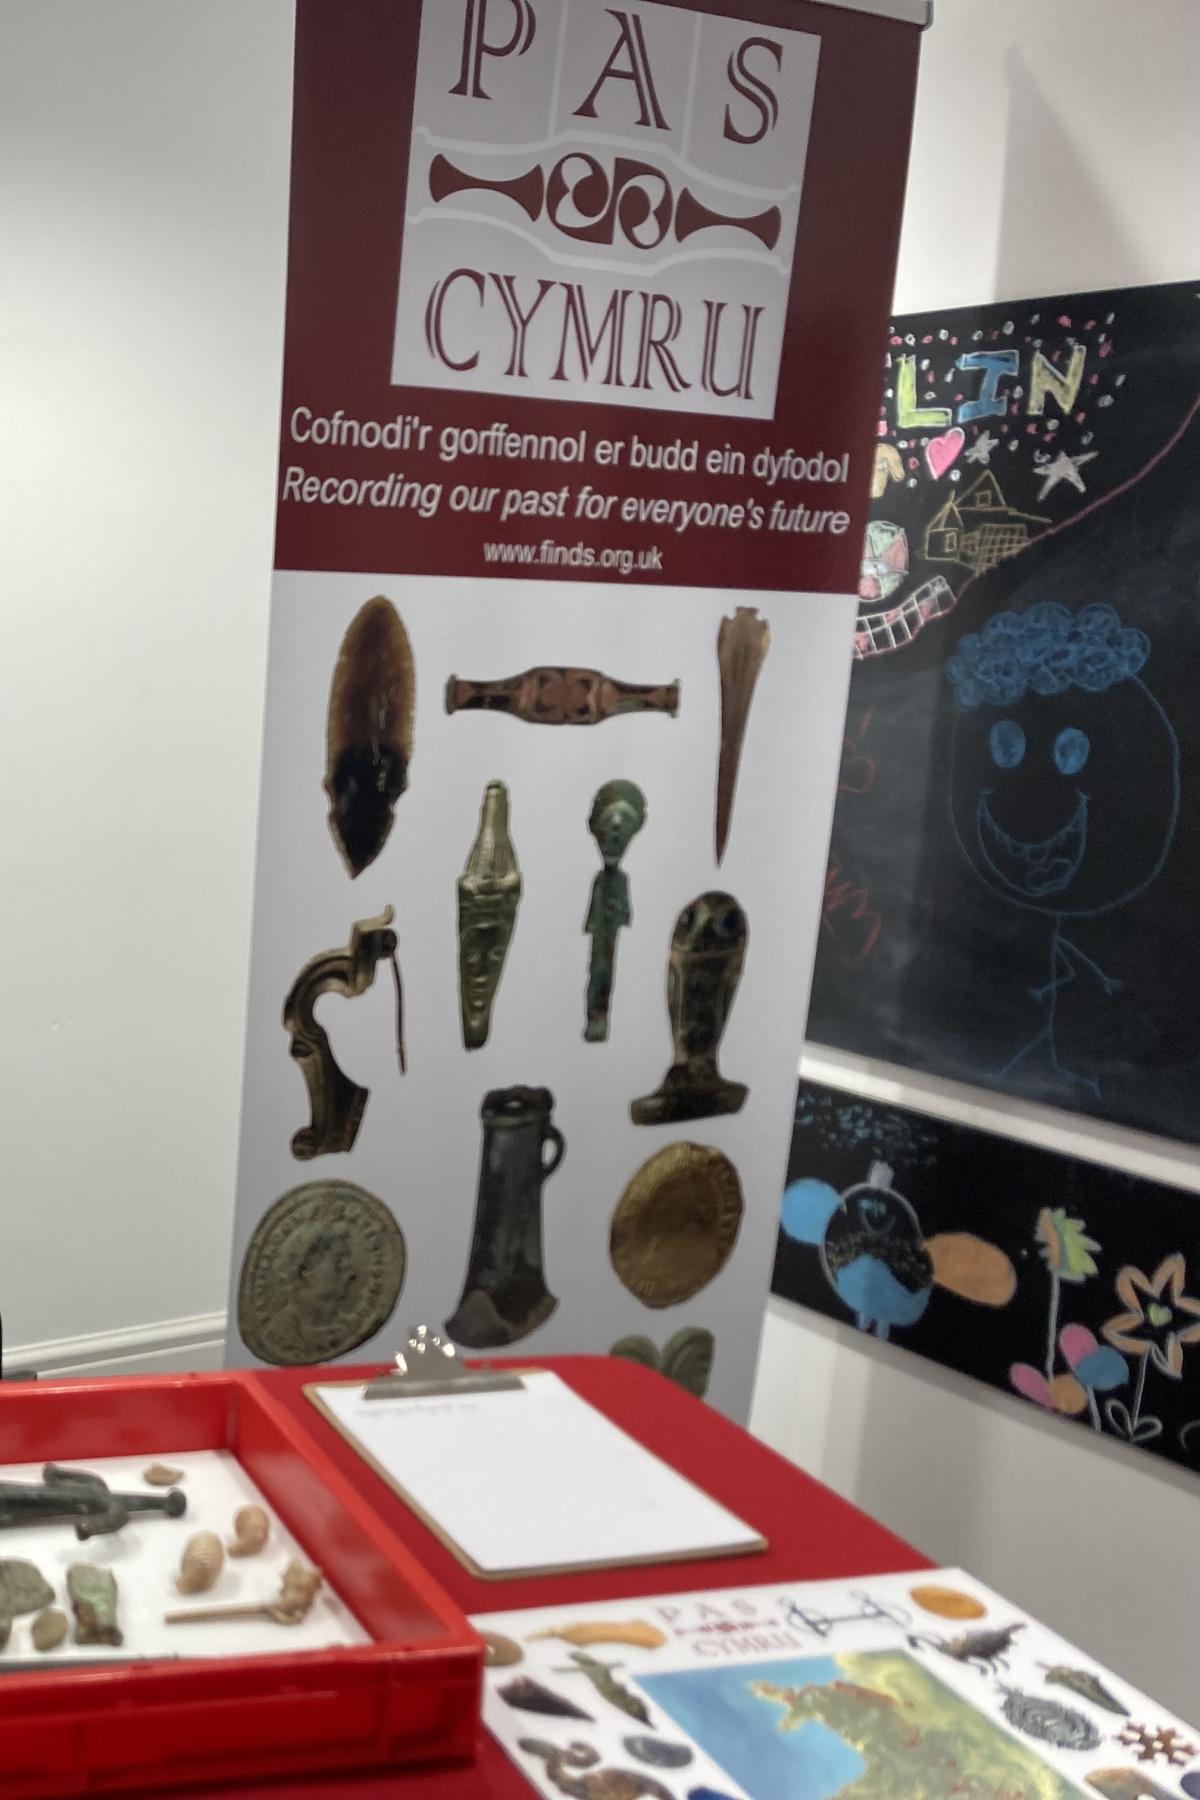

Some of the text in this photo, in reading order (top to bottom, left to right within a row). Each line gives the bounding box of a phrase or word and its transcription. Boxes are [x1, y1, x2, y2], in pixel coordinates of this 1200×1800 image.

[425, 267, 766, 401] CYMRU
[289, 405, 434, 451] Cofnodi'r
[439, 421, 587, 463] gorffennol
[594, 438, 626, 466] er
[629, 434, 700, 473] budd
[705, 443, 746, 476] ein
[752, 446, 851, 486] dyfodol
[282, 465, 851, 535] Recording our past for everyone's future
[483, 538, 664, 575] www.finds.org.uk
